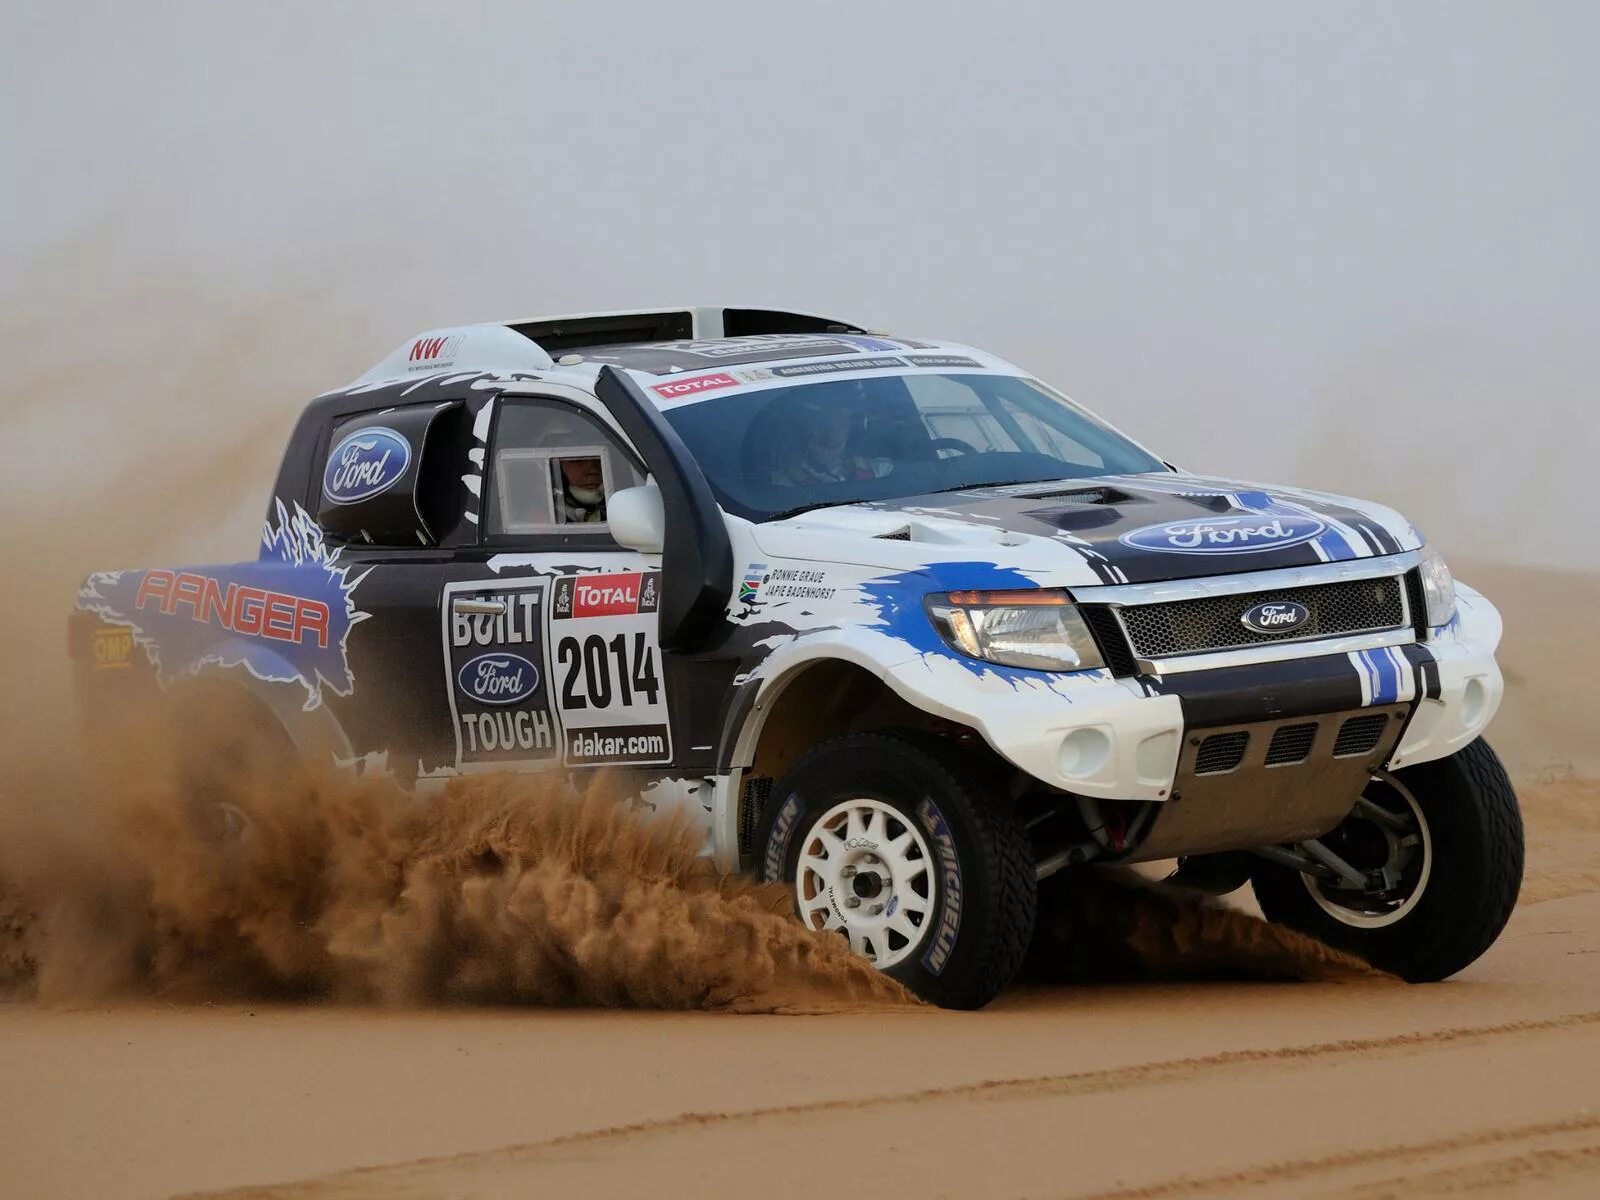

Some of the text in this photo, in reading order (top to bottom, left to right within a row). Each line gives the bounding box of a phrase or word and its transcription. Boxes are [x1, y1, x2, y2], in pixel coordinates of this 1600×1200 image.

[332, 440, 391, 492] Ford
[1164, 519, 1294, 548] Ford
[765, 585, 836, 600] JAPIE BADENHORST
[770, 569, 826, 584] RONNIE GRAUE
[136, 568, 330, 649] RANGER
[452, 593, 539, 647] BUILT
[1259, 605, 1297, 627] Ford
[474, 660, 523, 695] Ford
[557, 631, 660, 710] 2014
[462, 709, 551, 752] TOUGH
[573, 732, 664, 757] dakar.com
[929, 834, 960, 971] MICHELIN
